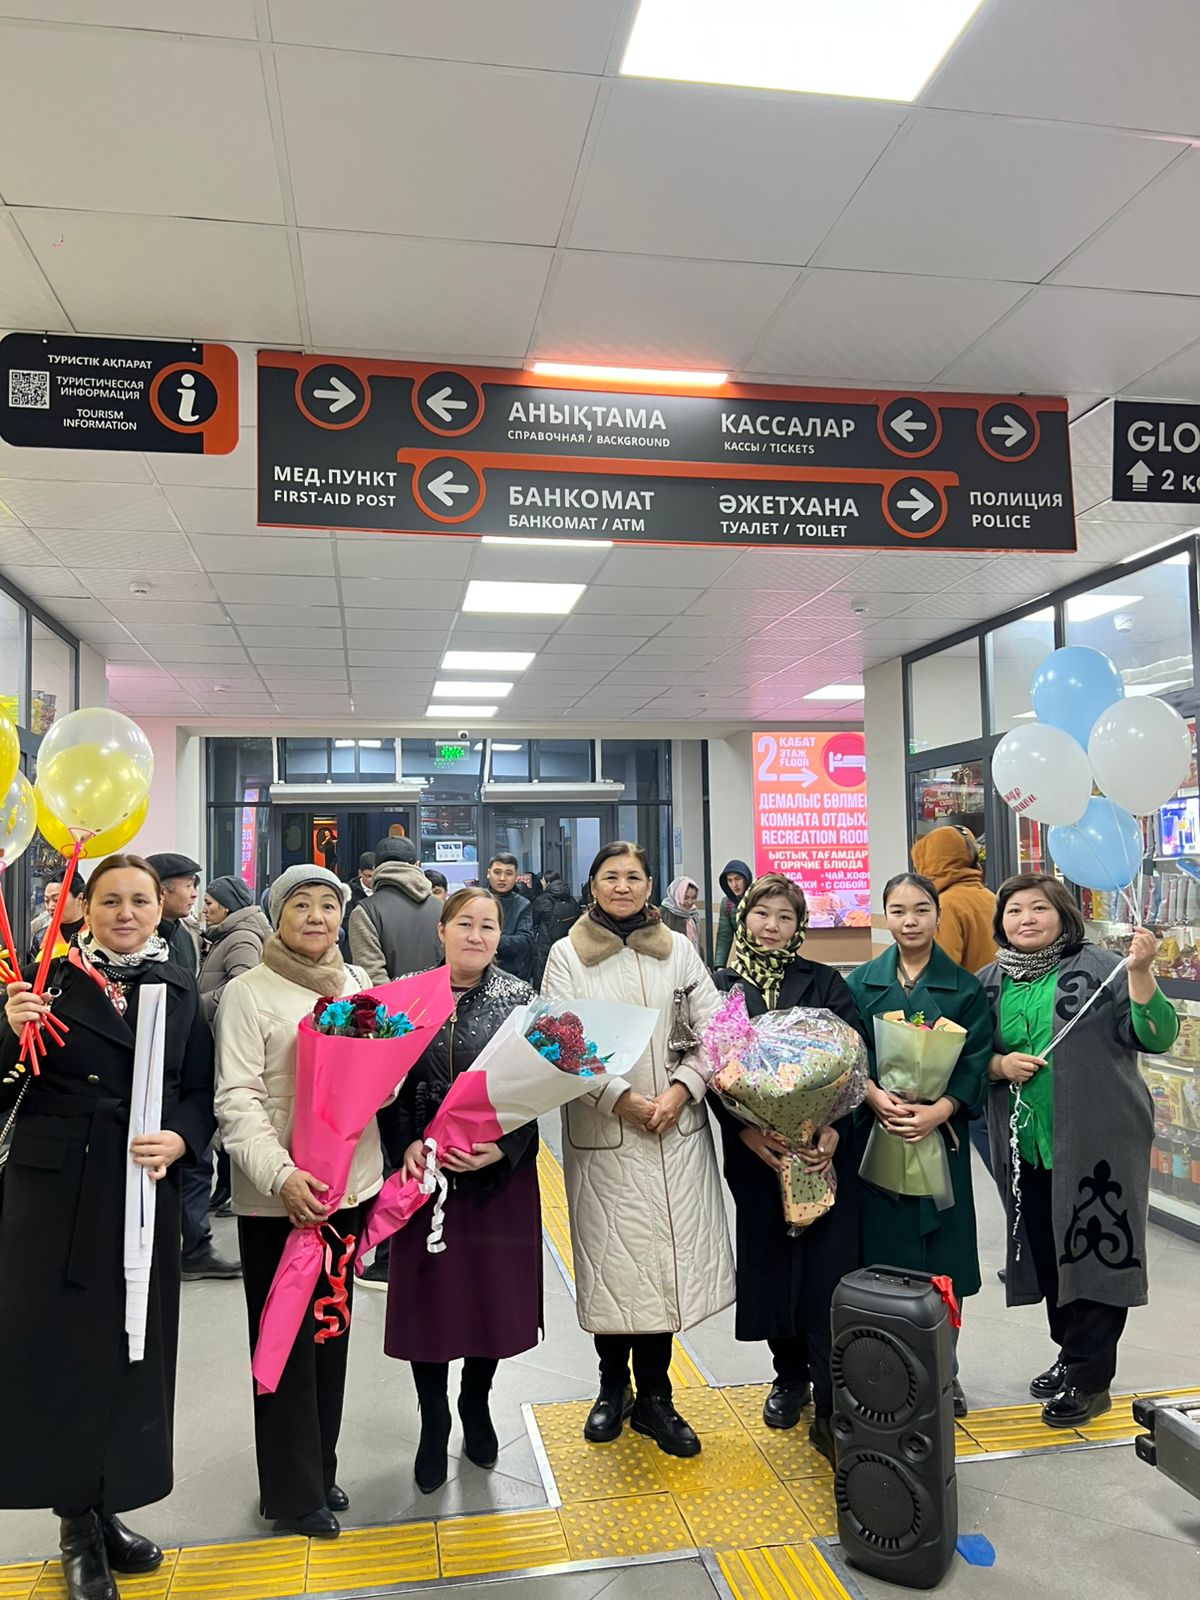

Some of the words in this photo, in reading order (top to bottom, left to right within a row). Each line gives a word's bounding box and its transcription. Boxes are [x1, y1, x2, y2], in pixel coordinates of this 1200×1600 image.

[48, 354, 100, 367] ТУРИСТІК
[102, 358, 152, 370] АҚПАРАТ
[56, 376, 144, 390] ТУРИСТИЧЕСКАЯ
[60, 387, 140, 401] ИНФОРМАЦИЯ
[76, 408, 124, 420] TOURISM
[508, 401, 667, 431] АНЫҚТАМА
[63, 418, 137, 431] INFORMATION
[721, 413, 856, 438] КАССАЛАР
[507, 430, 585, 444] СПРАВОЧНАЯ
[596, 435, 670, 448] BACKGROUND
[724, 441, 760, 453] КАССЫ
[769, 443, 815, 454] TICKETS
[274, 465, 398, 487] МЕД.ПУНКТ
[1161, 469, 1175, 490] 2
[274, 489, 351, 505] FIRST-AID
[356, 493, 396, 507] POST
[509, 486, 655, 511] БАНКОМАТ
[719, 494, 860, 517] ӘЖЕТХАНА
[969, 491, 1063, 510] ПОЛИЦИЯ
[508, 514, 598, 530] БАНКОМАТ
[612, 518, 645, 531] ATM
[720, 521, 779, 535] ТУАЛЕТ
[796, 524, 848, 537] TOILET
[972, 514, 1031, 528] POLICE
[757, 735, 778, 782] 2
[779, 749, 808, 758] ЭТАЖ
[779, 758, 809, 767] FLOOR
[759, 793, 821, 810] ДЕМАЛЫС
[760, 812, 819, 827] КОМНАТА
[822, 812, 868, 828] ОТДЫХ
[762, 829, 837, 844] RECREATION
[769, 850, 809, 860] ЫСТЫҚ
[811, 850, 868, 860] ТАҒАМДАР
[774, 860, 821, 870] ГОРЯЧИЕ
[824, 860, 864, 870] БЛЮДА
